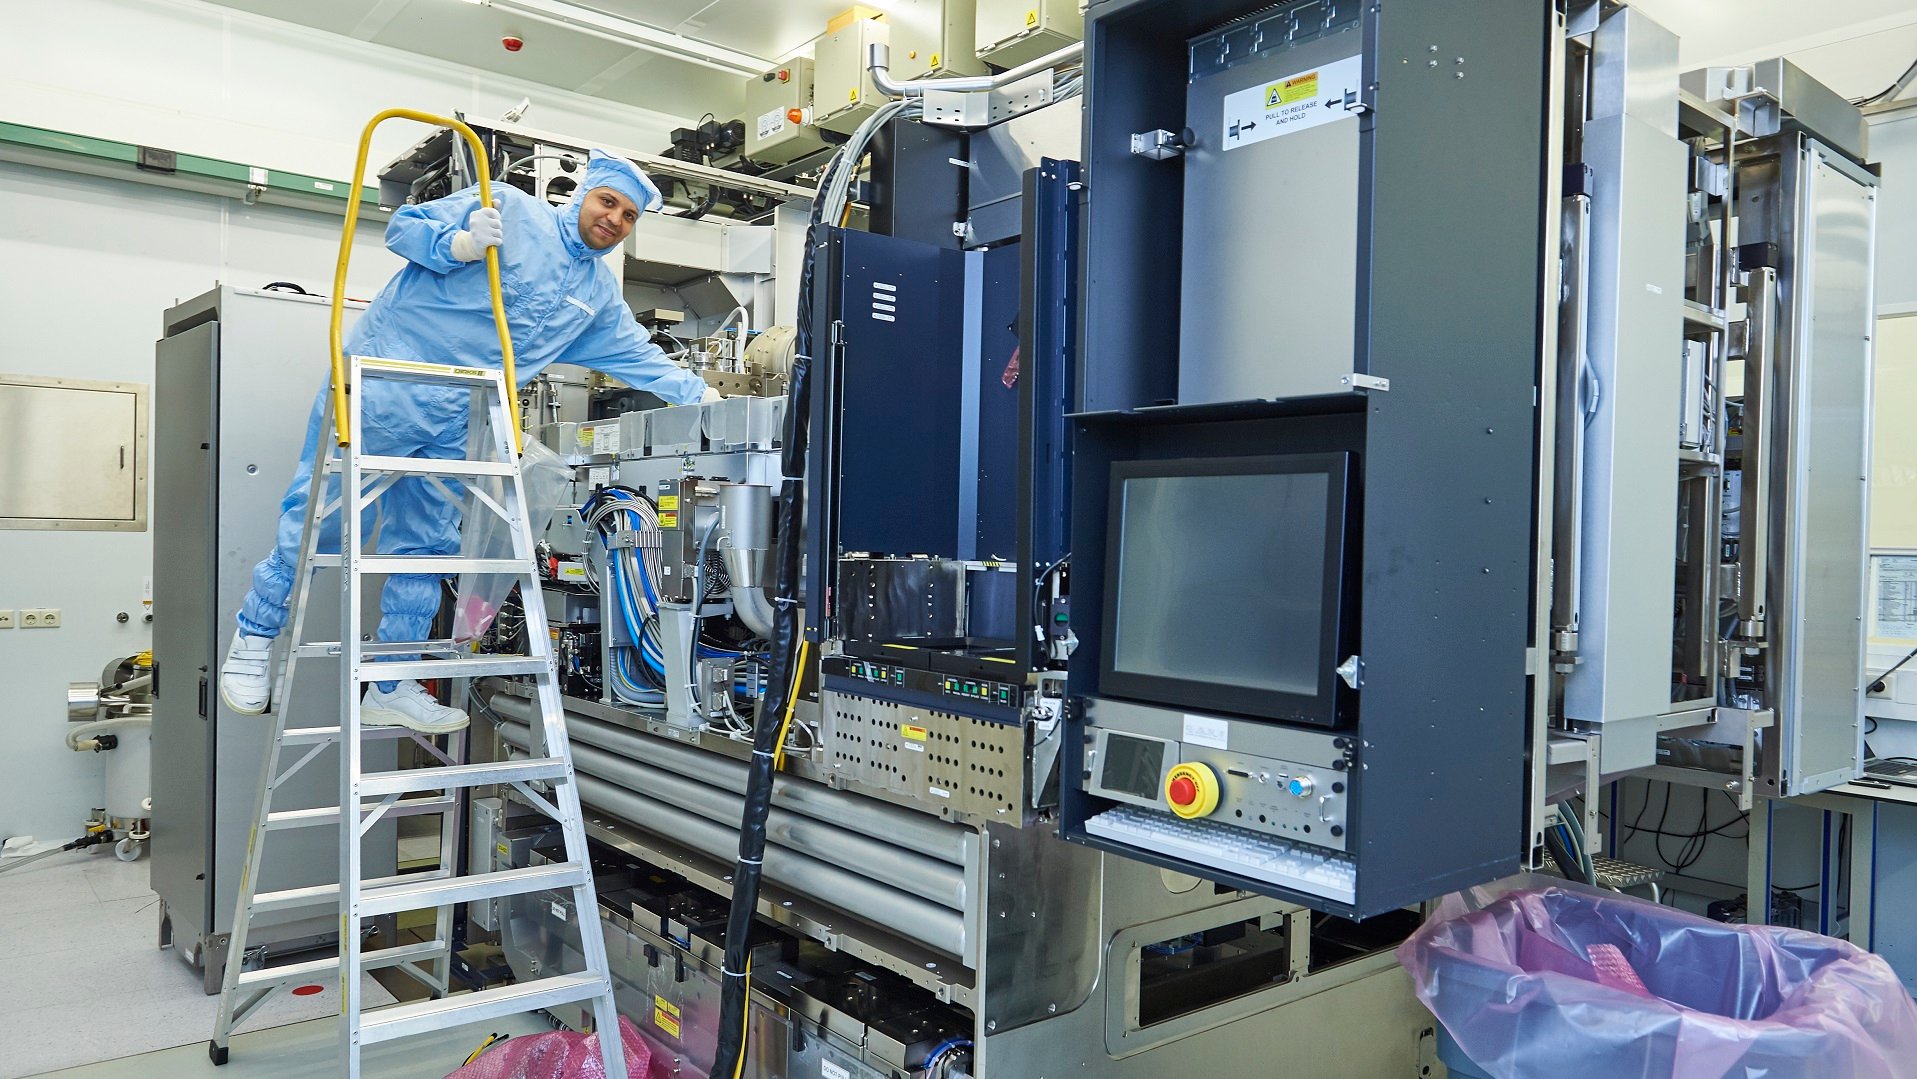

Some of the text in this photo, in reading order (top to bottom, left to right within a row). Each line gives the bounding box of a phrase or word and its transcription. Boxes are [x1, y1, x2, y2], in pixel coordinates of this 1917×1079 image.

[1292, 74, 1316, 84] WARNING
[1265, 112, 1280, 120] PULL
[1291, 101, 1318, 113] RELEASE
[1289, 113, 1306, 122] HOLD
